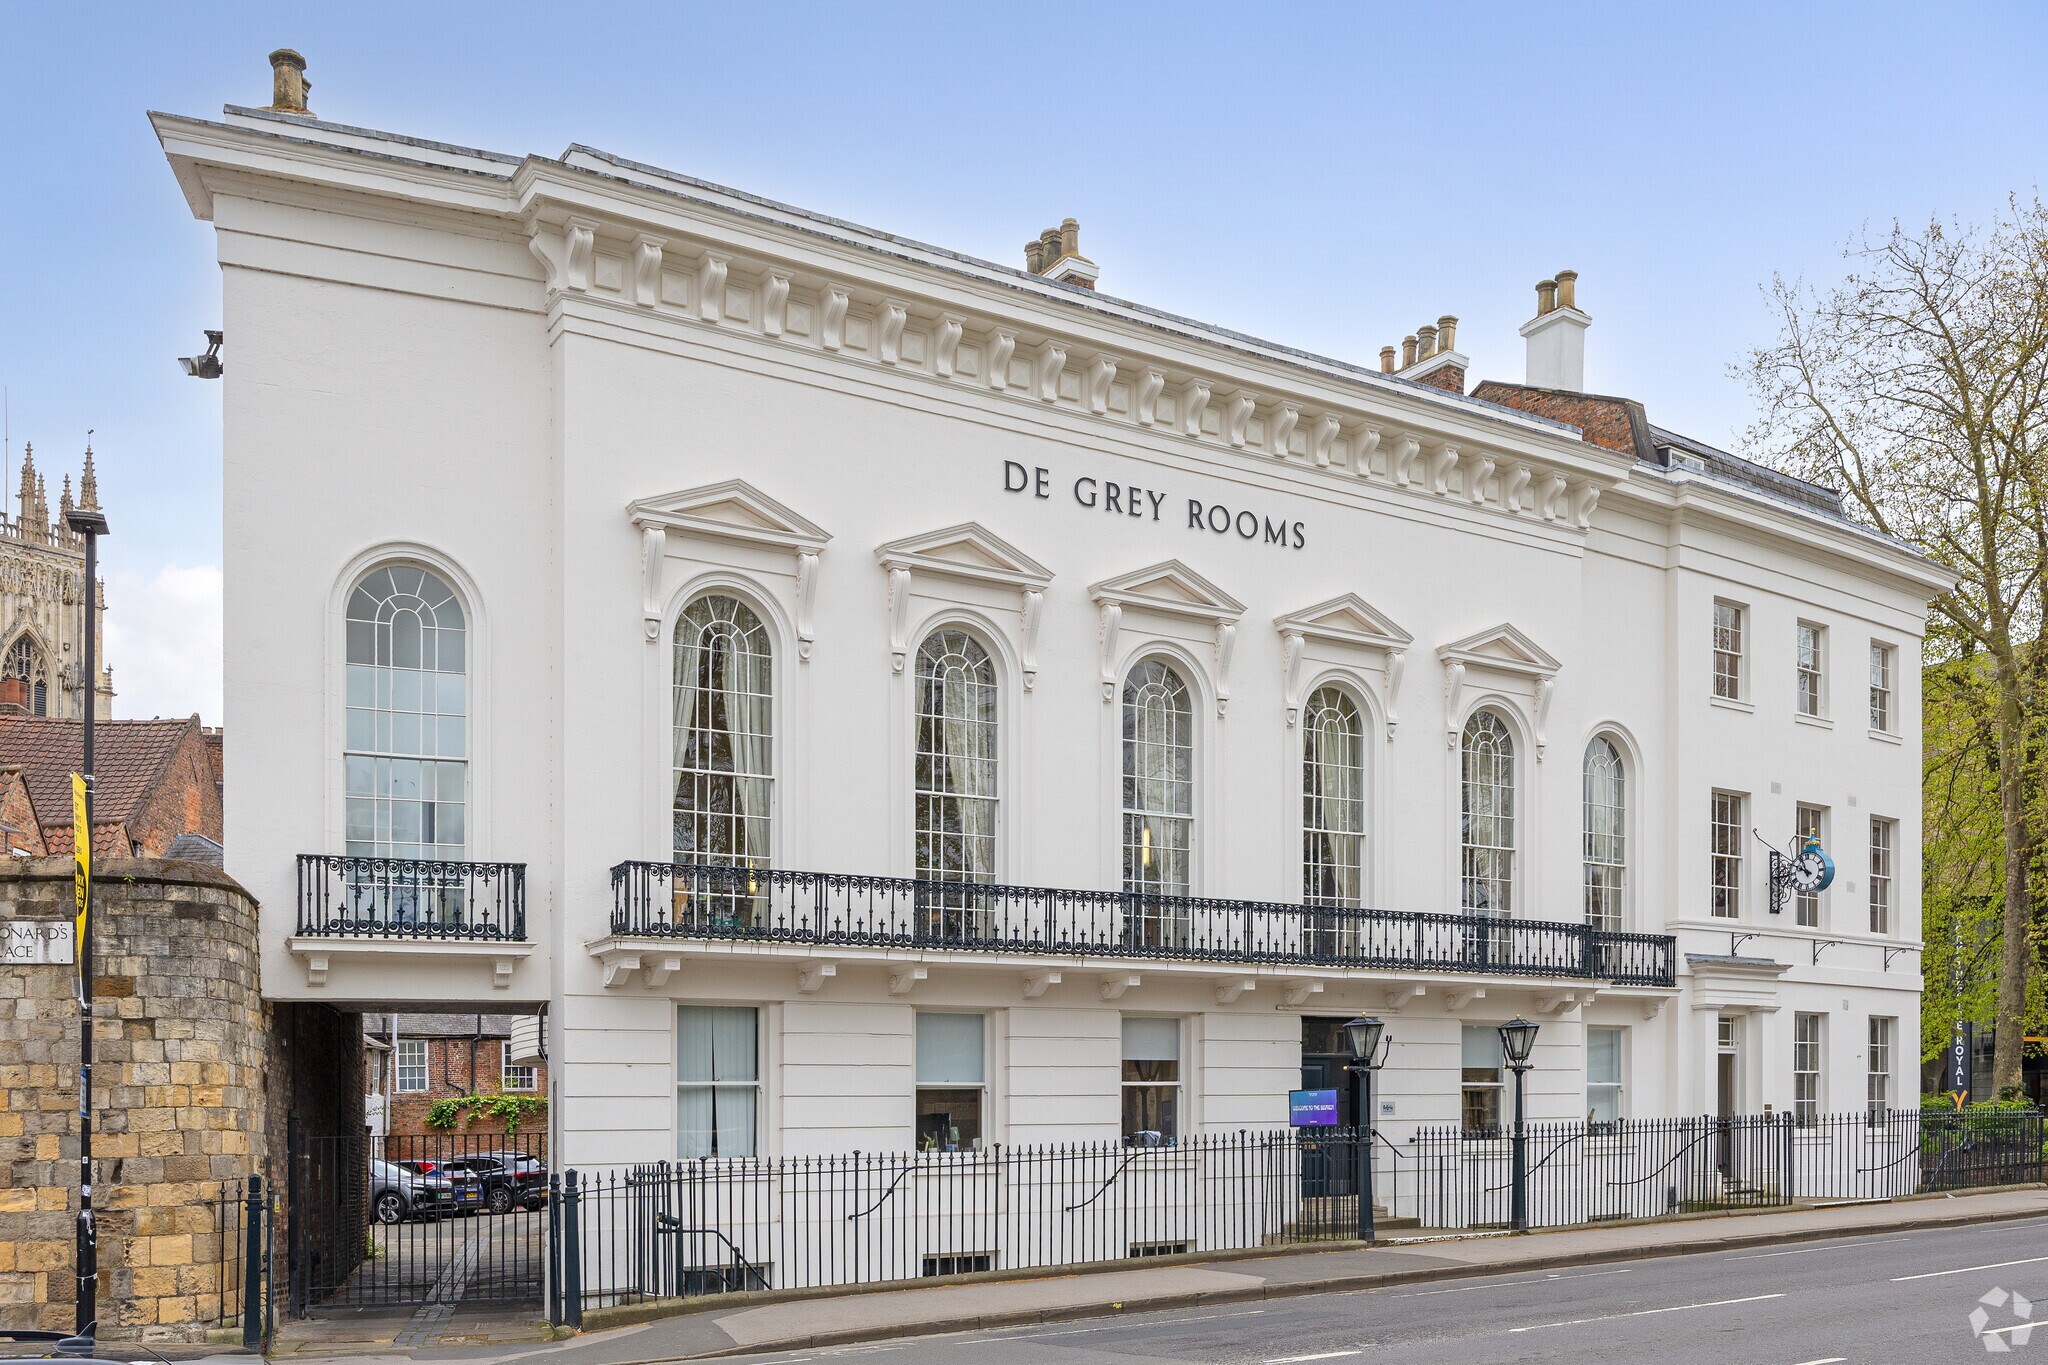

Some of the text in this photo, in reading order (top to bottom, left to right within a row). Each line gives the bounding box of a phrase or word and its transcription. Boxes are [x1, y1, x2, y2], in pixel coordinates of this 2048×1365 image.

[1003, 459, 1306, 550] DE GREY ROOMS
[1955, 1036, 1964, 1086] ROYAL
